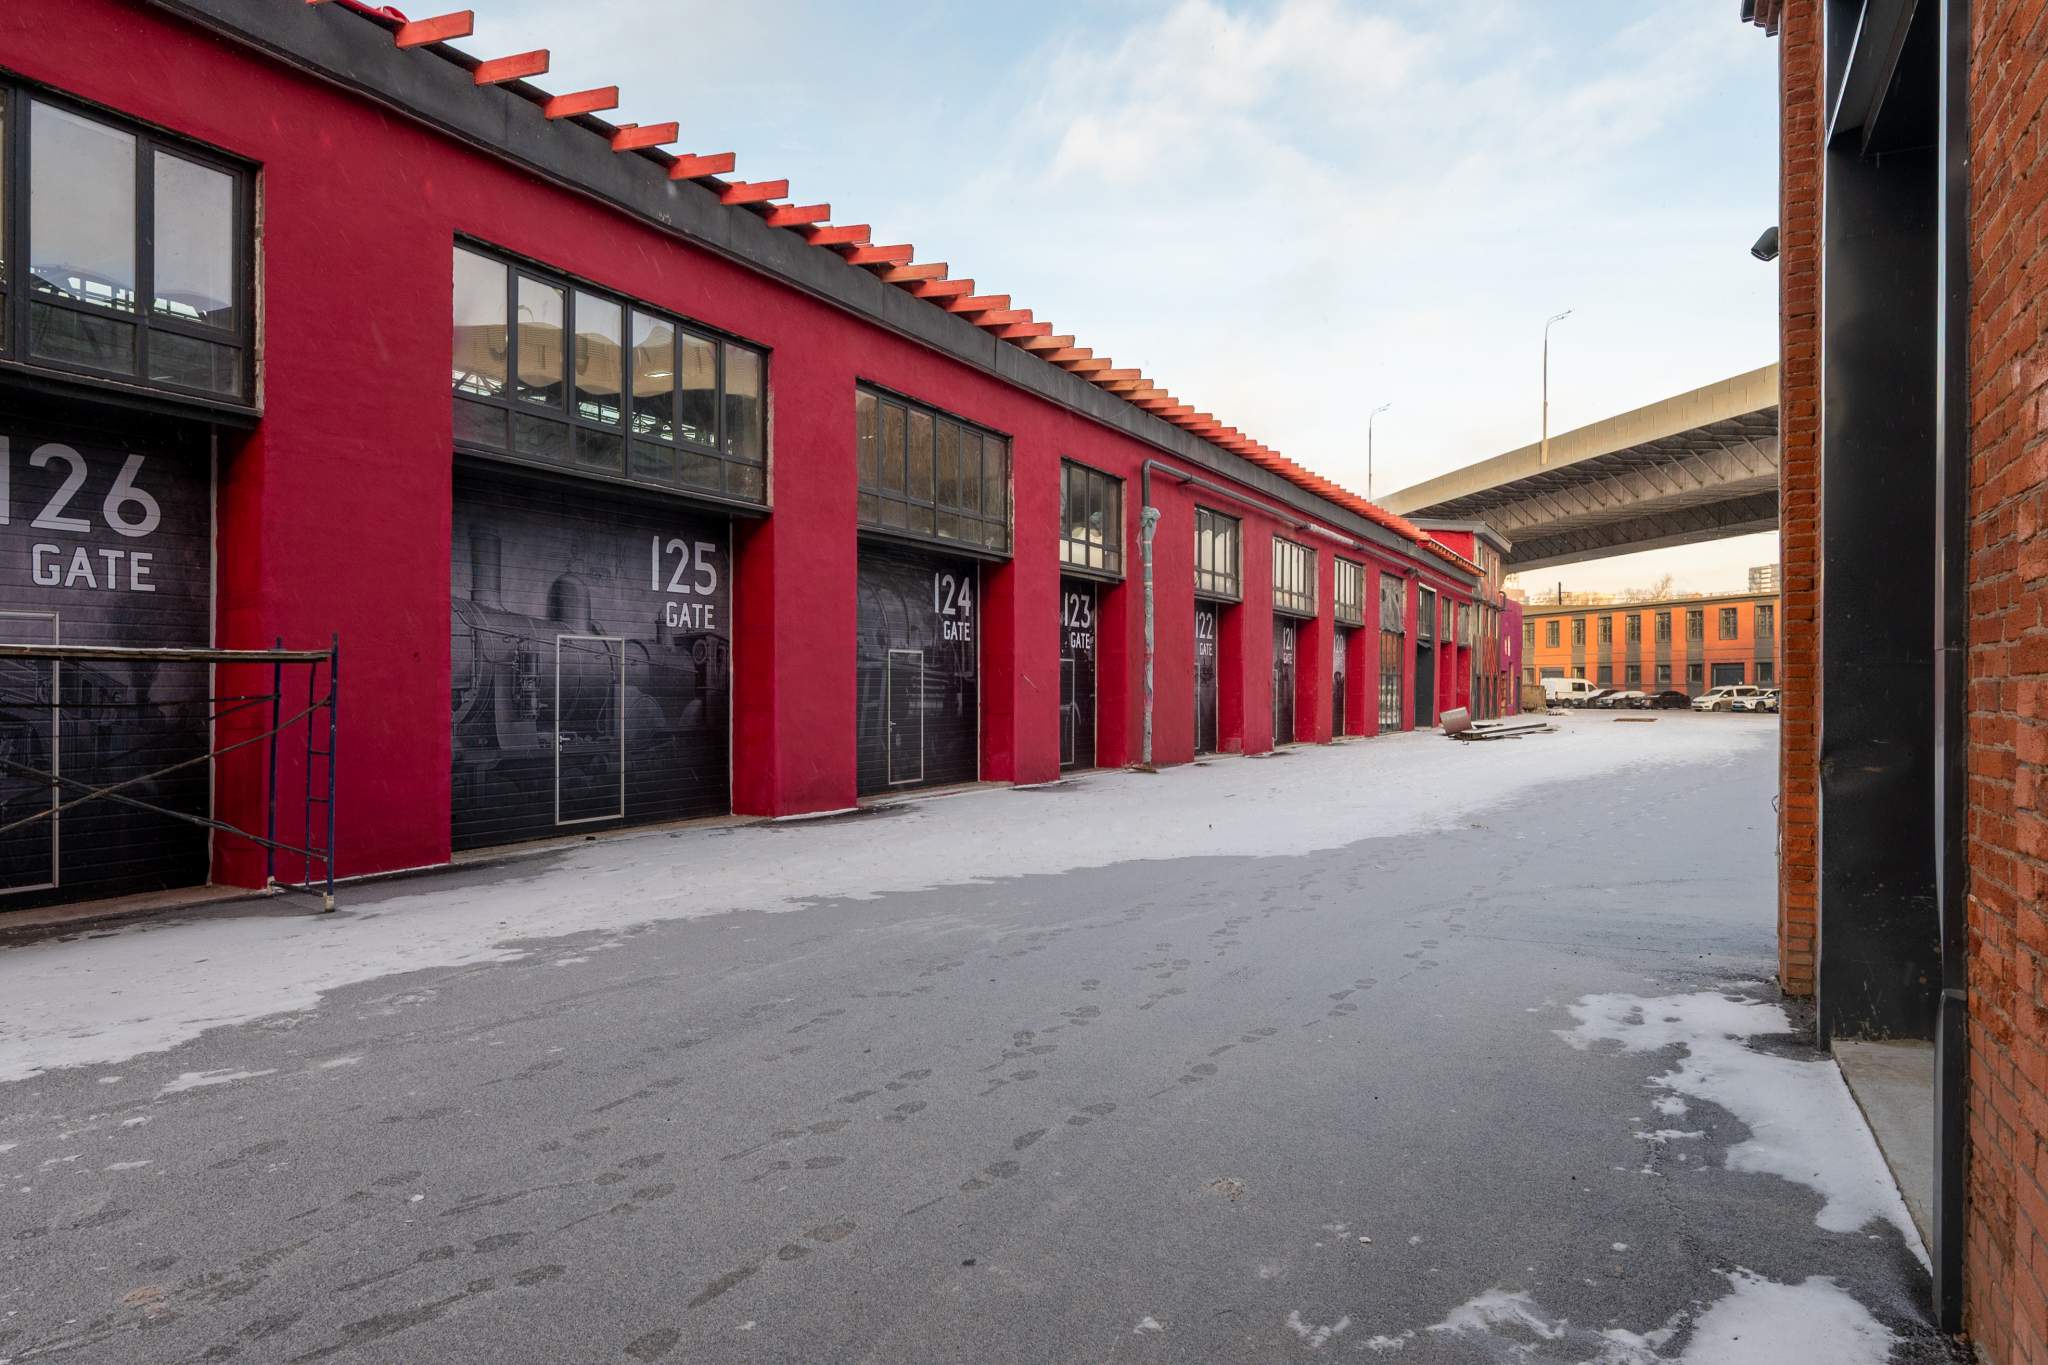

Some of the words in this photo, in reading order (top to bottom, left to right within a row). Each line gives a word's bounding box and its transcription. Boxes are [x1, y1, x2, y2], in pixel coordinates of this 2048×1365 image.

[32, 543, 156, 591] GATE
[651, 535, 717, 596] 125
[934, 572, 972, 617] 124
[666, 601, 715, 629] GATE
[1064, 592, 1091, 628] 123
[943, 620, 971, 641] GATE
[1195, 611, 1213, 640] 122
[1283, 627, 1293, 650] 121
[1070, 632, 1091, 649] GATE
[1199, 642, 1213, 657] GATE
